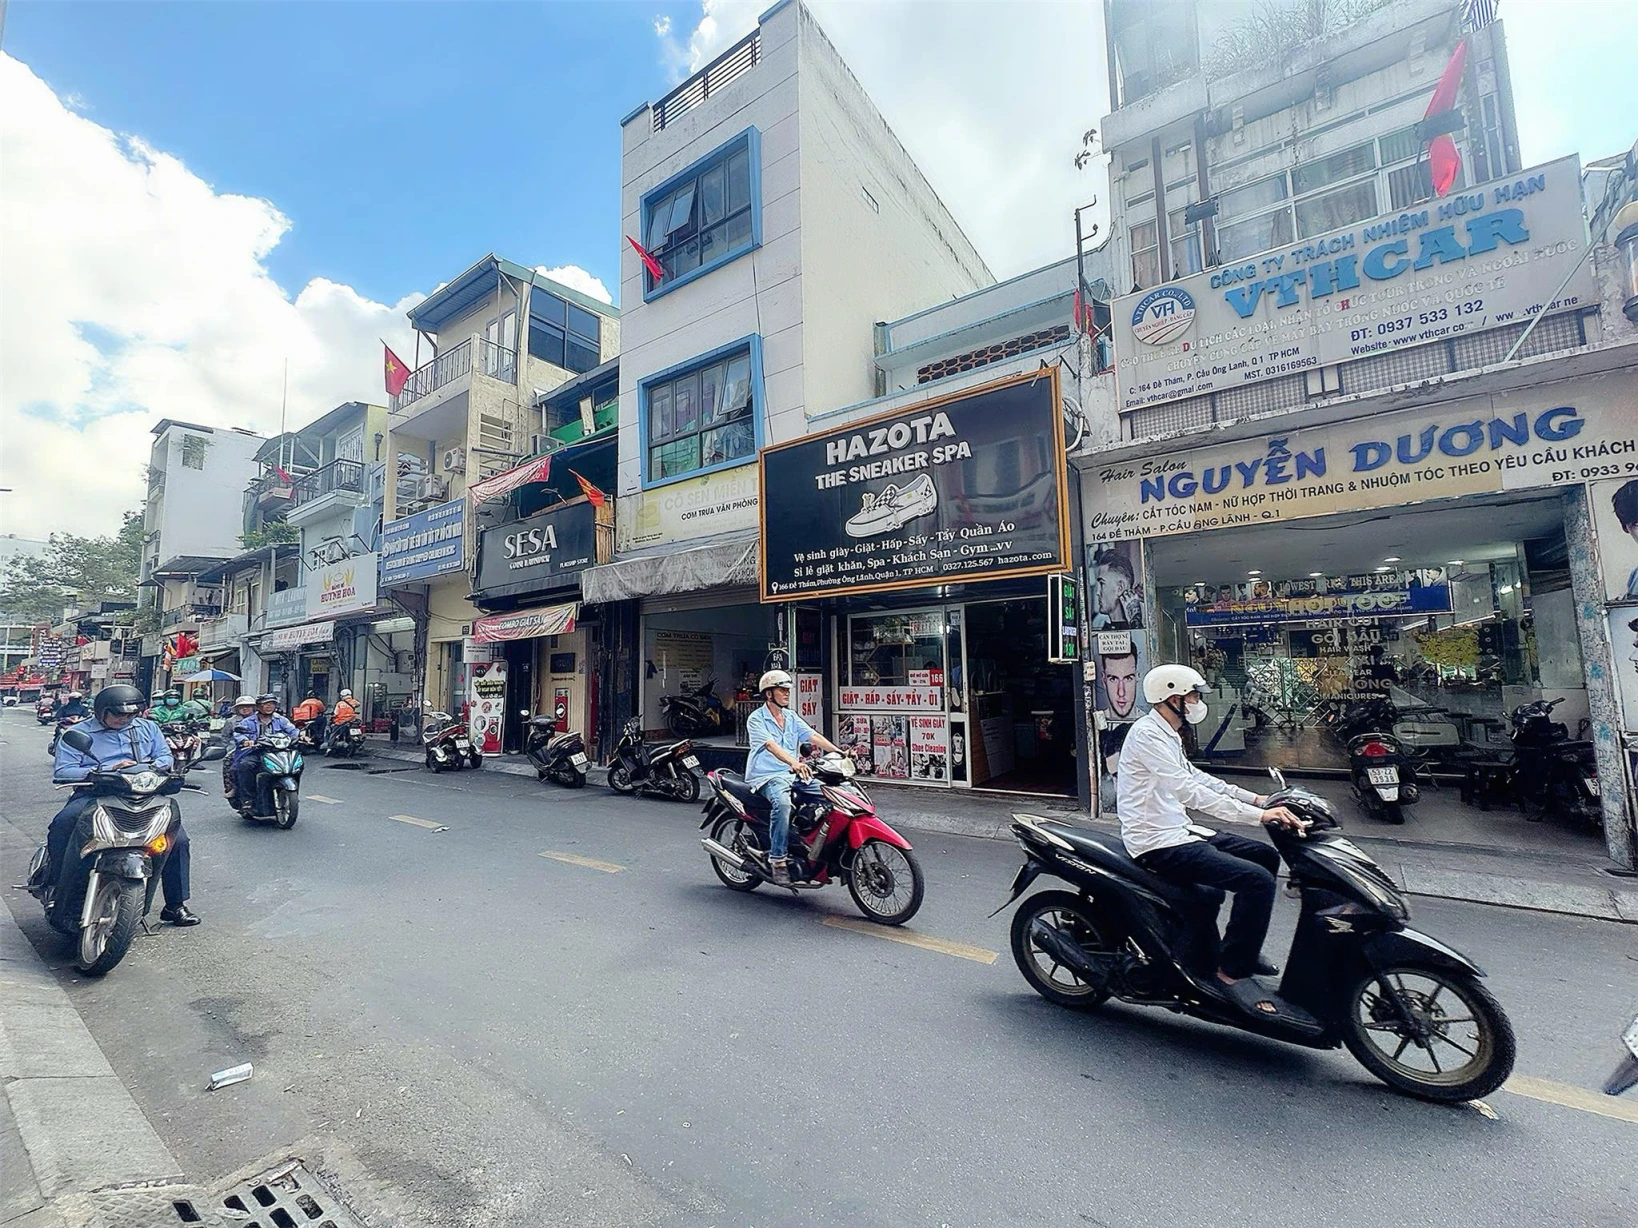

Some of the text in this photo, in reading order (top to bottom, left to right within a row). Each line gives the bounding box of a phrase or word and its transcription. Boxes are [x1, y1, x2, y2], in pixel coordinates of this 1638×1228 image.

[1210, 173, 1546, 289] CÔNG TY TRÁCH NHIỆM HỮU HẠN
[1225, 208, 1530, 318] VTHCAR
[1134, 293, 1160, 321] VTHCAR
[1150, 300, 1175, 319] VTH
[1351, 299, 1485, 343] ĐT: 0937 533 132
[1182, 340, 1197, 354] DU
[1139, 378, 1151, 392] 164
[1251, 353, 1259, 367] Q
[1269, 349, 1282, 362] TP
[1281, 346, 1300, 359] HCM
[1244, 355, 1318, 381] MST. 0316169563
[826, 411, 957, 467] HAZOTA
[815, 441, 973, 491] THE SNEAKER SPA
[1140, 406, 1586, 505] NGUYỄN DƯƠNG
[1091, 438, 1635, 530] Chuyên: CẮT TÓC NAM NỮ HỢP THỜI TRANG & NHUỘM TÓC THEO YÊU CẦU KHÁCH
[1099, 459, 1188, 484] Hair Salon
[1552, 463, 1620, 482] ĐT: 0933
[1091, 532, 1107, 542] 164
[1261, 509, 1281, 520] Q.1
[504, 524, 558, 560] SESA
[807, 550, 826, 562] sinh
[960, 523, 993, 539] Quần
[998, 520, 1016, 533] Áo
[817, 563, 834, 577] giặt
[867, 557, 887, 572] Spa
[893, 551, 927, 569] Khách
[930, 547, 951, 563] Sạn
[960, 543, 990, 557] Gym
[903, 567, 914, 576] TP
[914, 565, 934, 575] HCM
[943, 558, 994, 572] 0327.125.567
[342, 586, 356, 598] HOA
[800, 676, 818, 695] GIẶT
[842, 690, 859, 706] GIẶT
[865, 690, 880, 705] HẤP
[906, 688, 922, 706] TẨY
[929, 690, 938, 706] ỦI
[802, 696, 818, 716] SẤY
[912, 743, 947, 755] Shoe Cleaning
[922, 732, 935, 741] 70K
[1055, 853, 1097, 876] VISION
